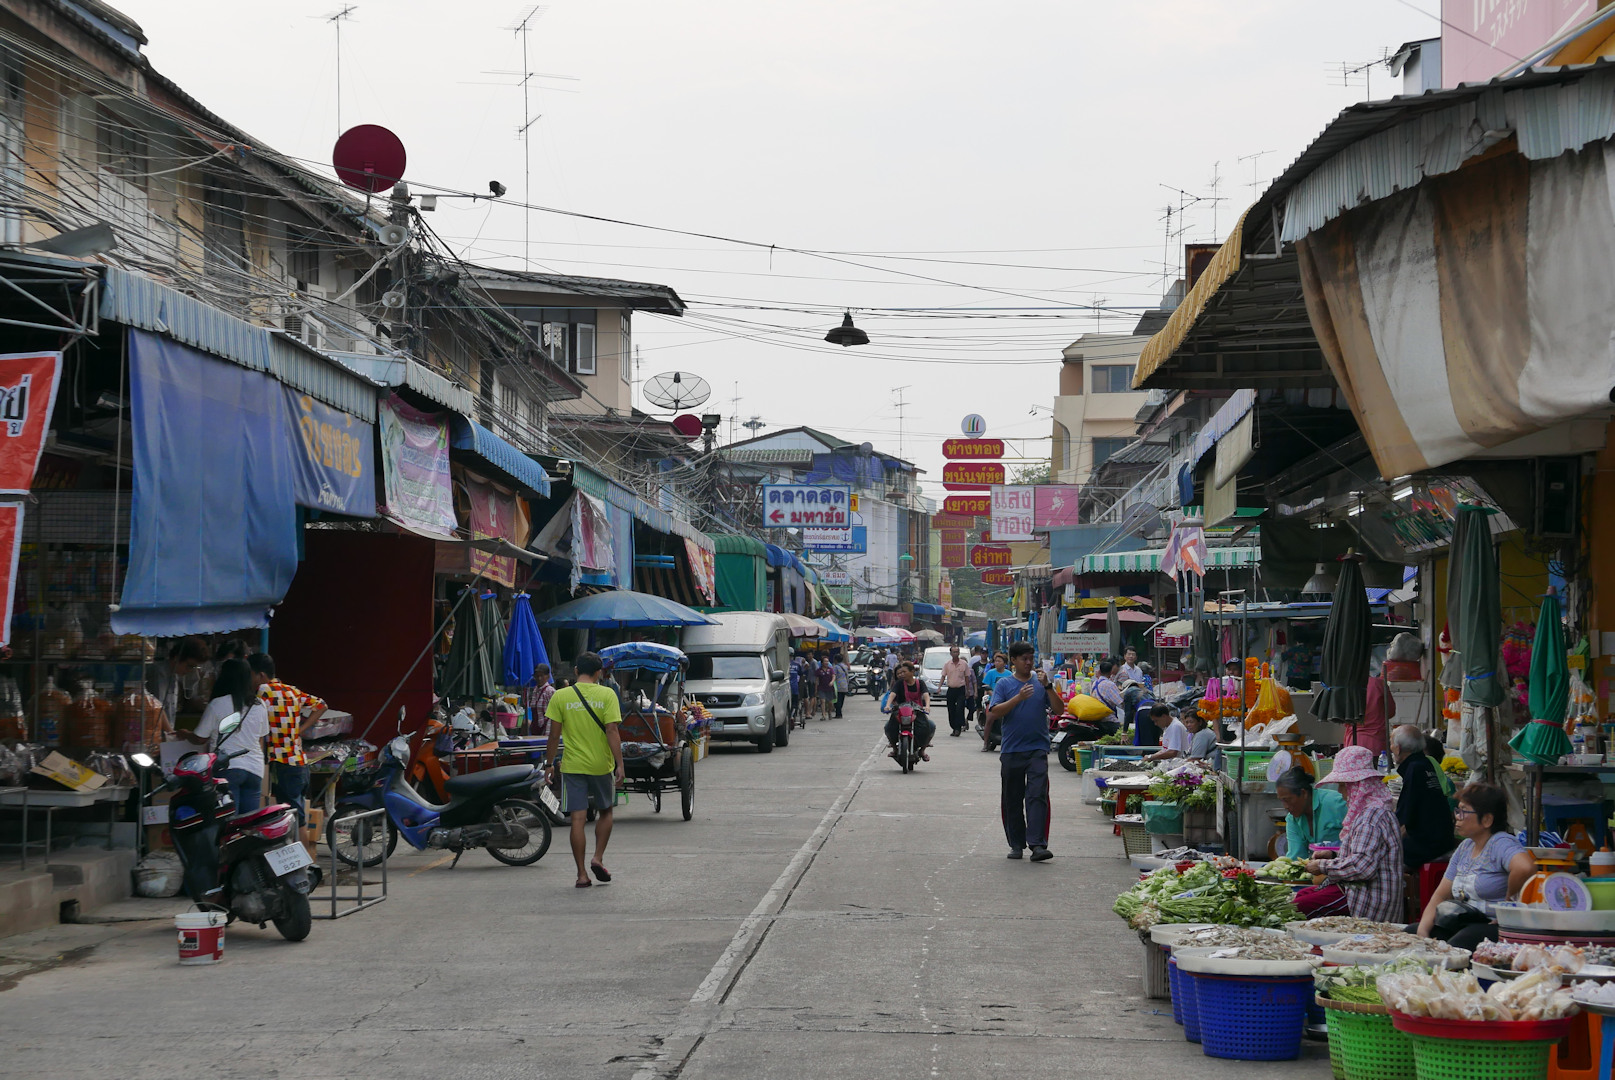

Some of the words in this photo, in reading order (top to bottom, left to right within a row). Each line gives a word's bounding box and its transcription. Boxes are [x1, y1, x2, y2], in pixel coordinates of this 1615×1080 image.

[947, 440, 1000, 455] ห้างทอง
[769, 489, 844, 504] ตลาดสด
[791, 506, 845, 523] มหาชัย
[996, 516, 1031, 535] ทอง
